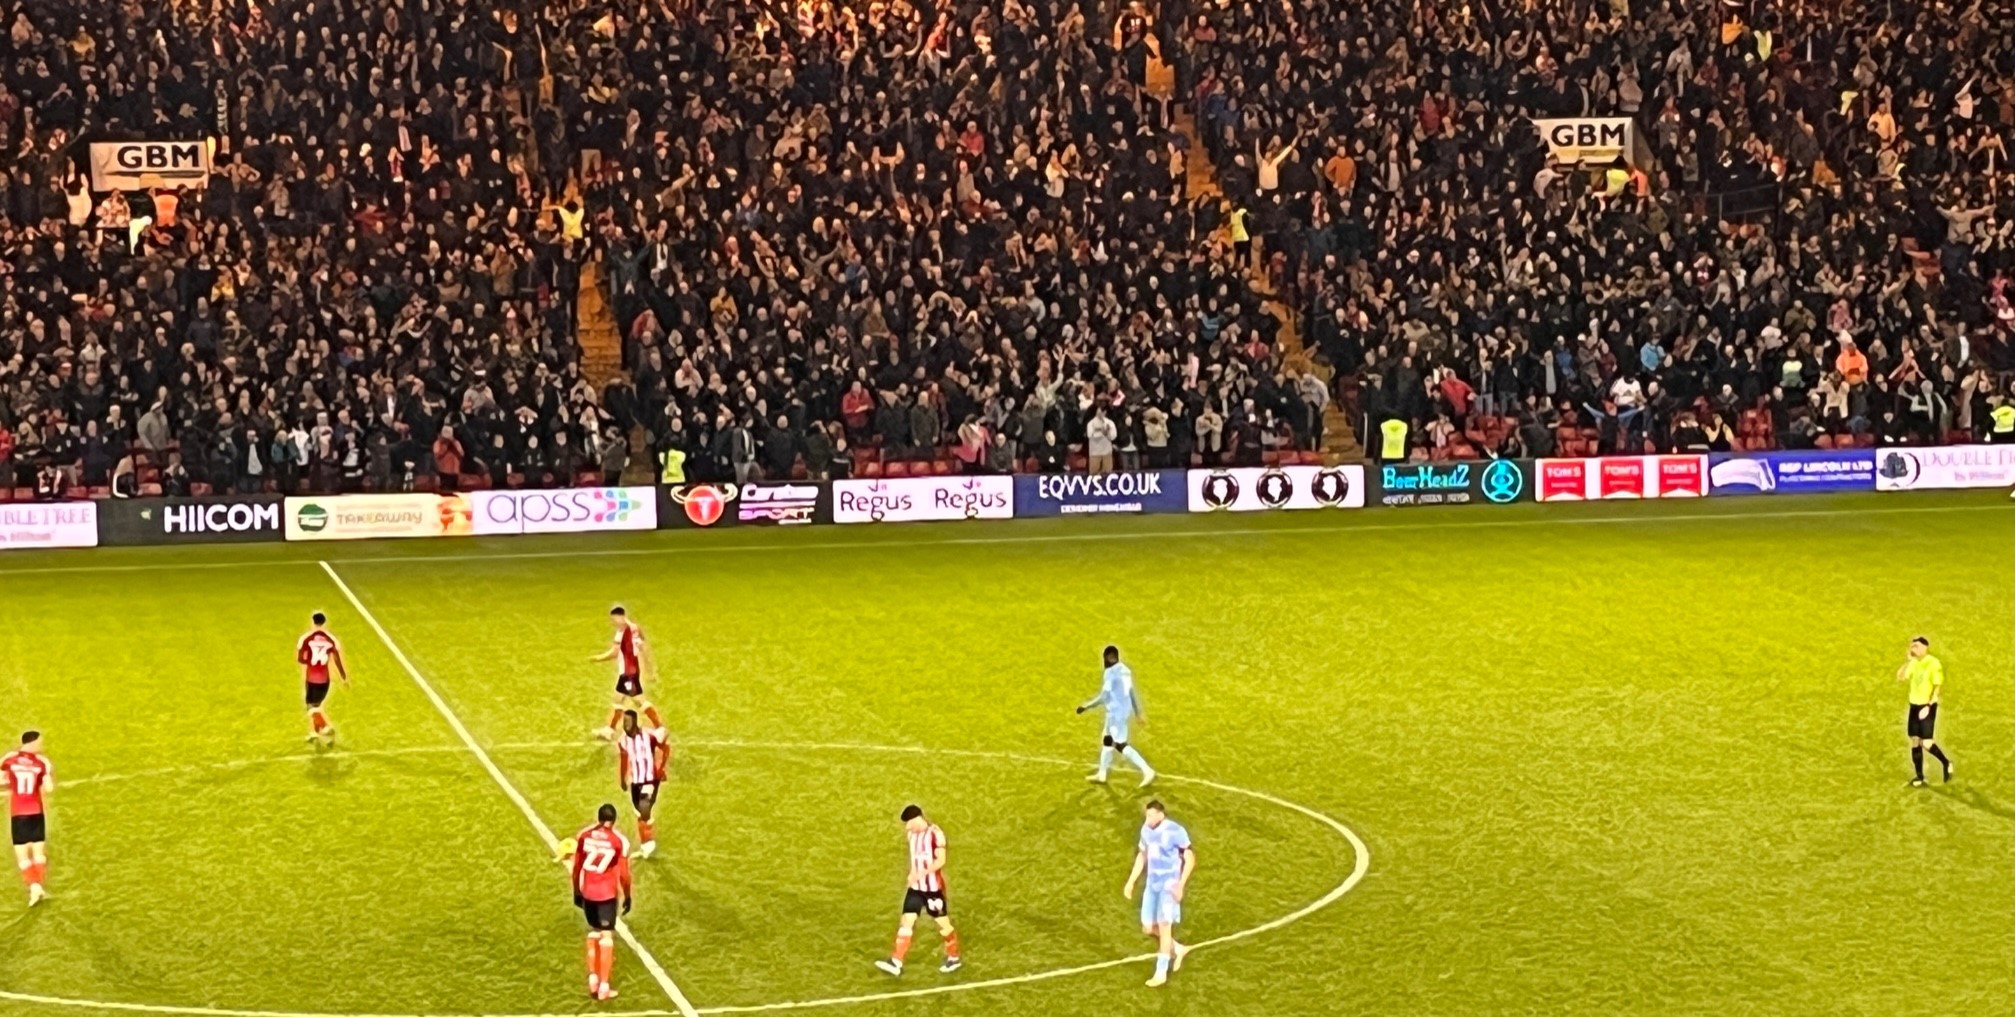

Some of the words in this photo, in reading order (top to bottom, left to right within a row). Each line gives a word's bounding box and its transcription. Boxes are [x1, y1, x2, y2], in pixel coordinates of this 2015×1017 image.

[1551, 123, 1625, 147] GBM
[117, 145, 199, 168] GBM
[1039, 473, 1161, 500] EQVVS.CO.UK
[487, 492, 590, 534] apss
[840, 491, 912, 521] Regus
[935, 488, 1007, 519] Regus
[164, 503, 279, 533] HIICOM
[17, 770, 36, 794] 11
[583, 847, 616, 874] 27
